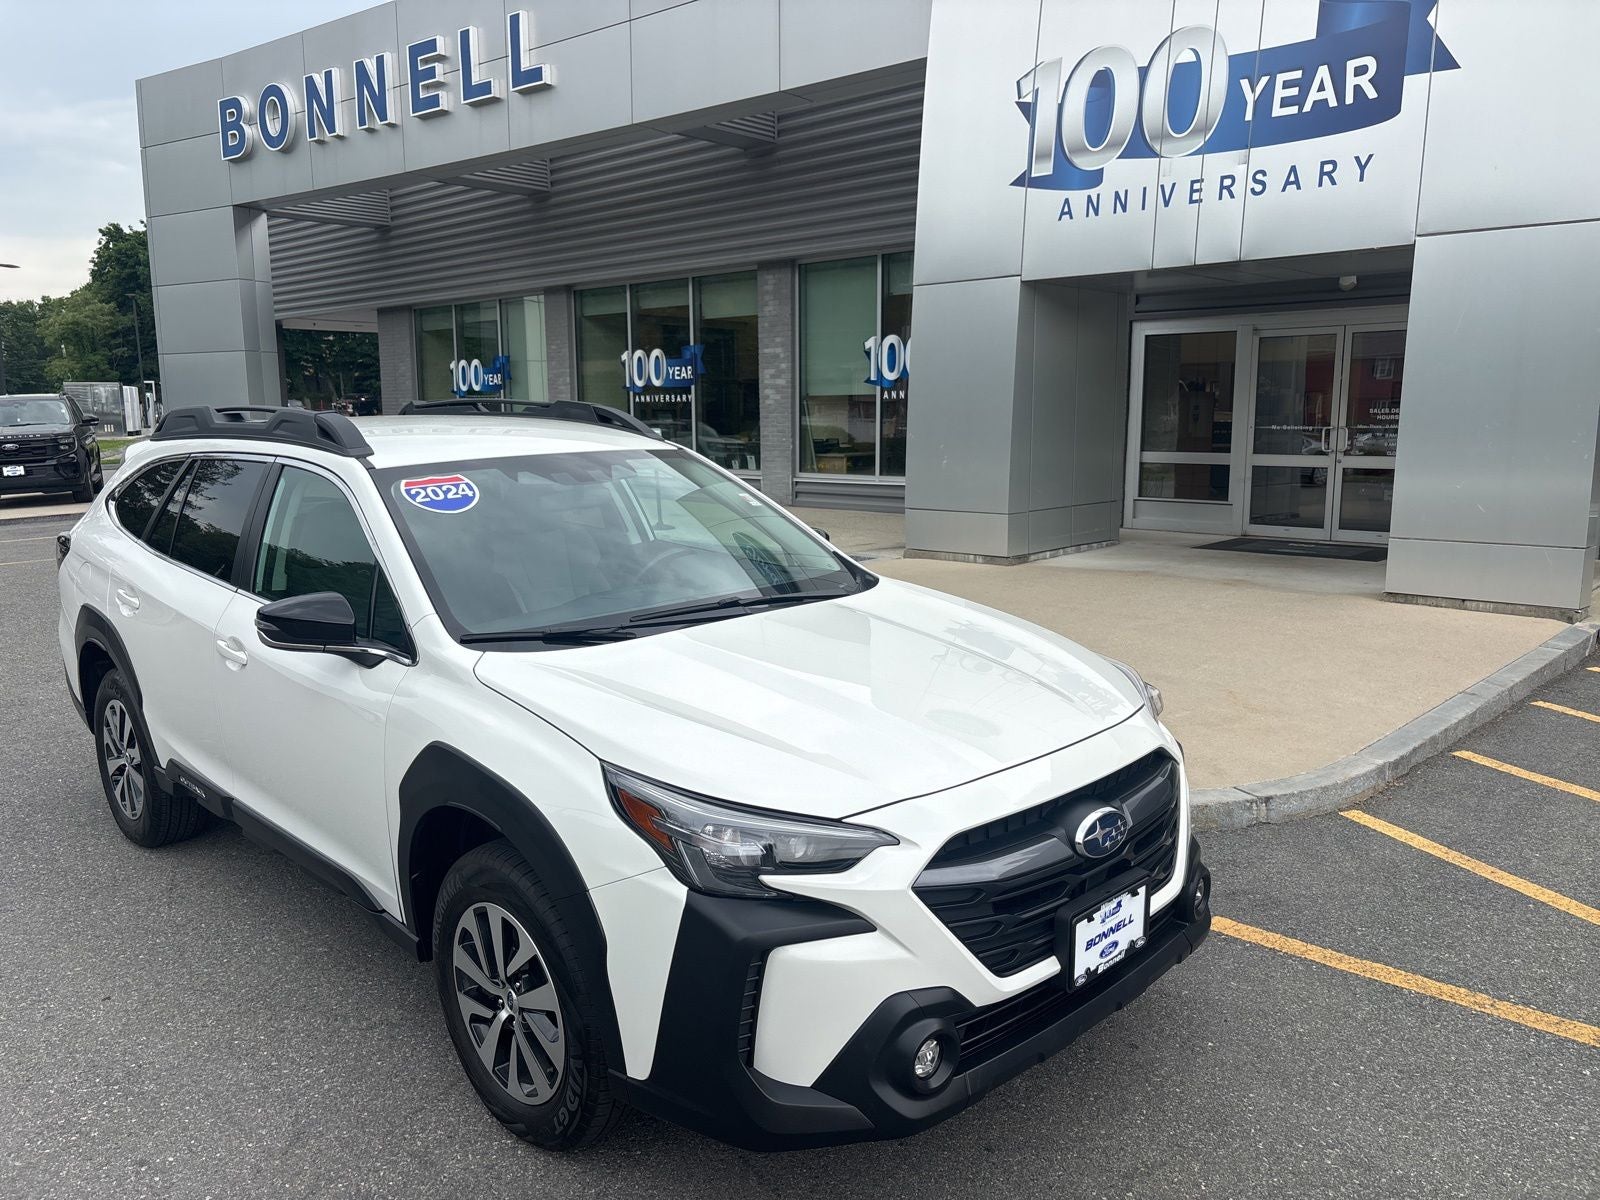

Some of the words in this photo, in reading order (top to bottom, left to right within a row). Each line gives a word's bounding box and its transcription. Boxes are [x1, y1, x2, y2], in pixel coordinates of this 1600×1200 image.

[217, 9, 553, 162] BONNELL
[1017, 24, 1229, 178] 100
[1239, 54, 1379, 123] YEAR
[1058, 153, 1376, 222] ANNIVERSARY
[449, 358, 483, 392] 100
[483, 373, 503, 386] YEAR
[620, 347, 667, 388] 100
[667, 365, 694, 380] YEAR
[635, 394, 693, 403] ANNIVERSARY
[410, 483, 474, 503] 2024
[1084, 914, 1135, 952] BONNELL
[1097, 949, 1126, 975] Bonnell
